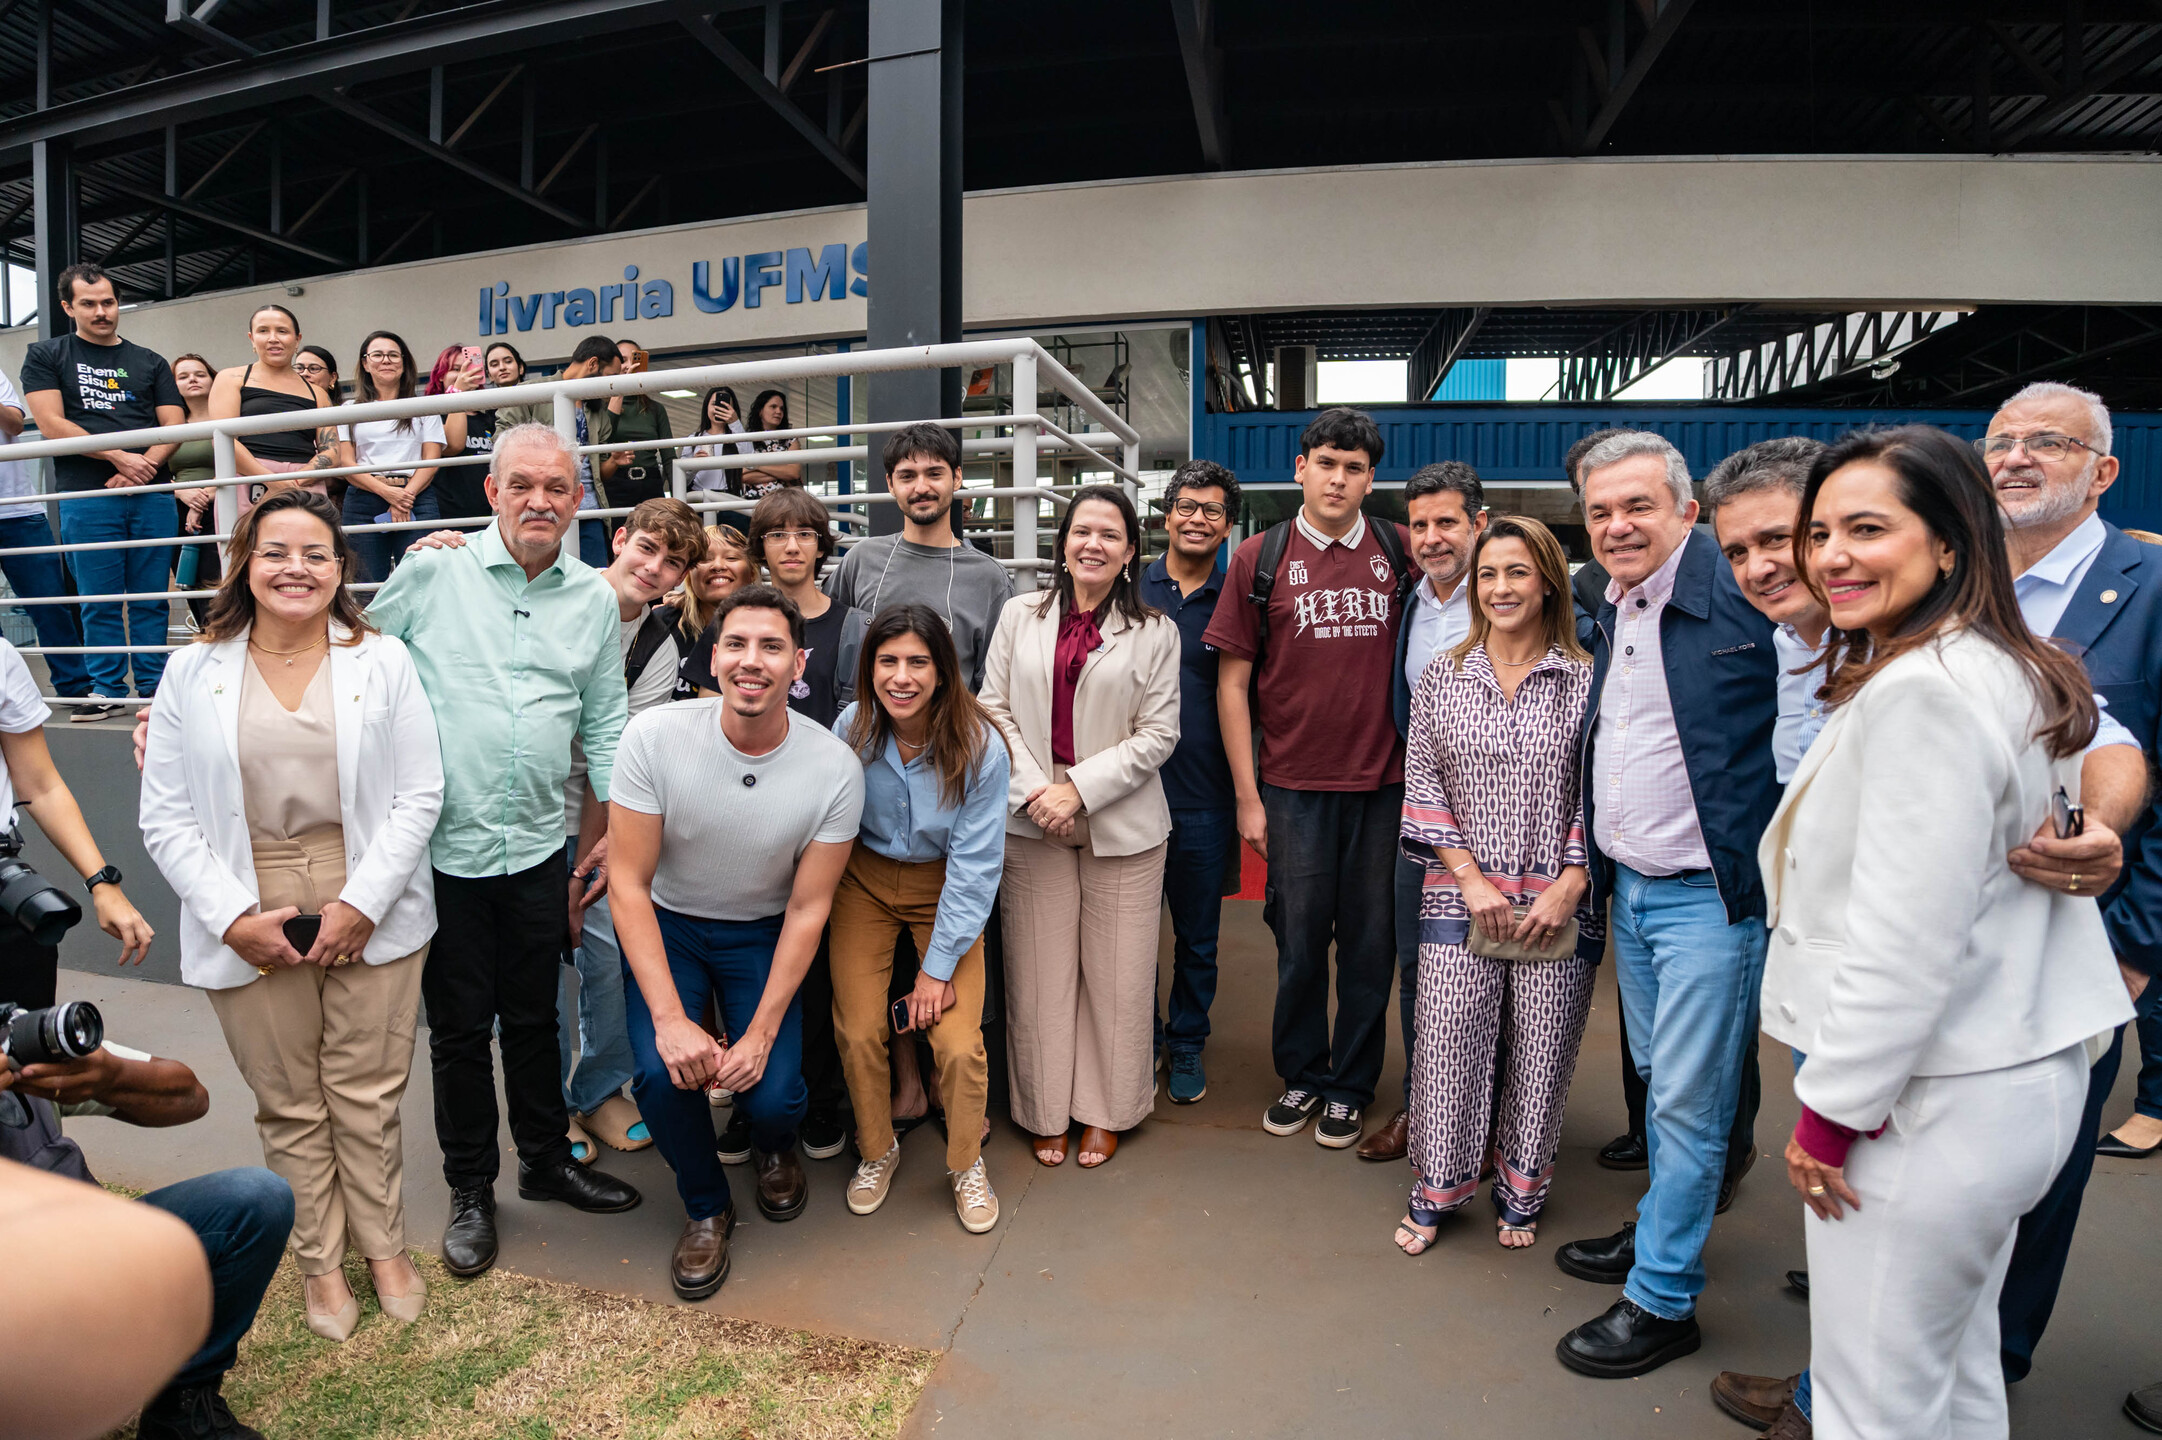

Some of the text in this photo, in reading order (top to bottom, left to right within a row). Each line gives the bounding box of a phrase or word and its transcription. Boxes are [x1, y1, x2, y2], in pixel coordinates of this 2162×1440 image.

[479, 264, 673, 336] livraria
[77, 363, 128, 377] Enem&
[78, 374, 120, 389] Sisu&
[79, 385, 136, 402] Prouni&
[82, 398, 116, 410] Fies.
[1288, 569, 1309, 586] 99
[1332, 626, 1340, 638] BY
[1342, 625, 1353, 637] THE
